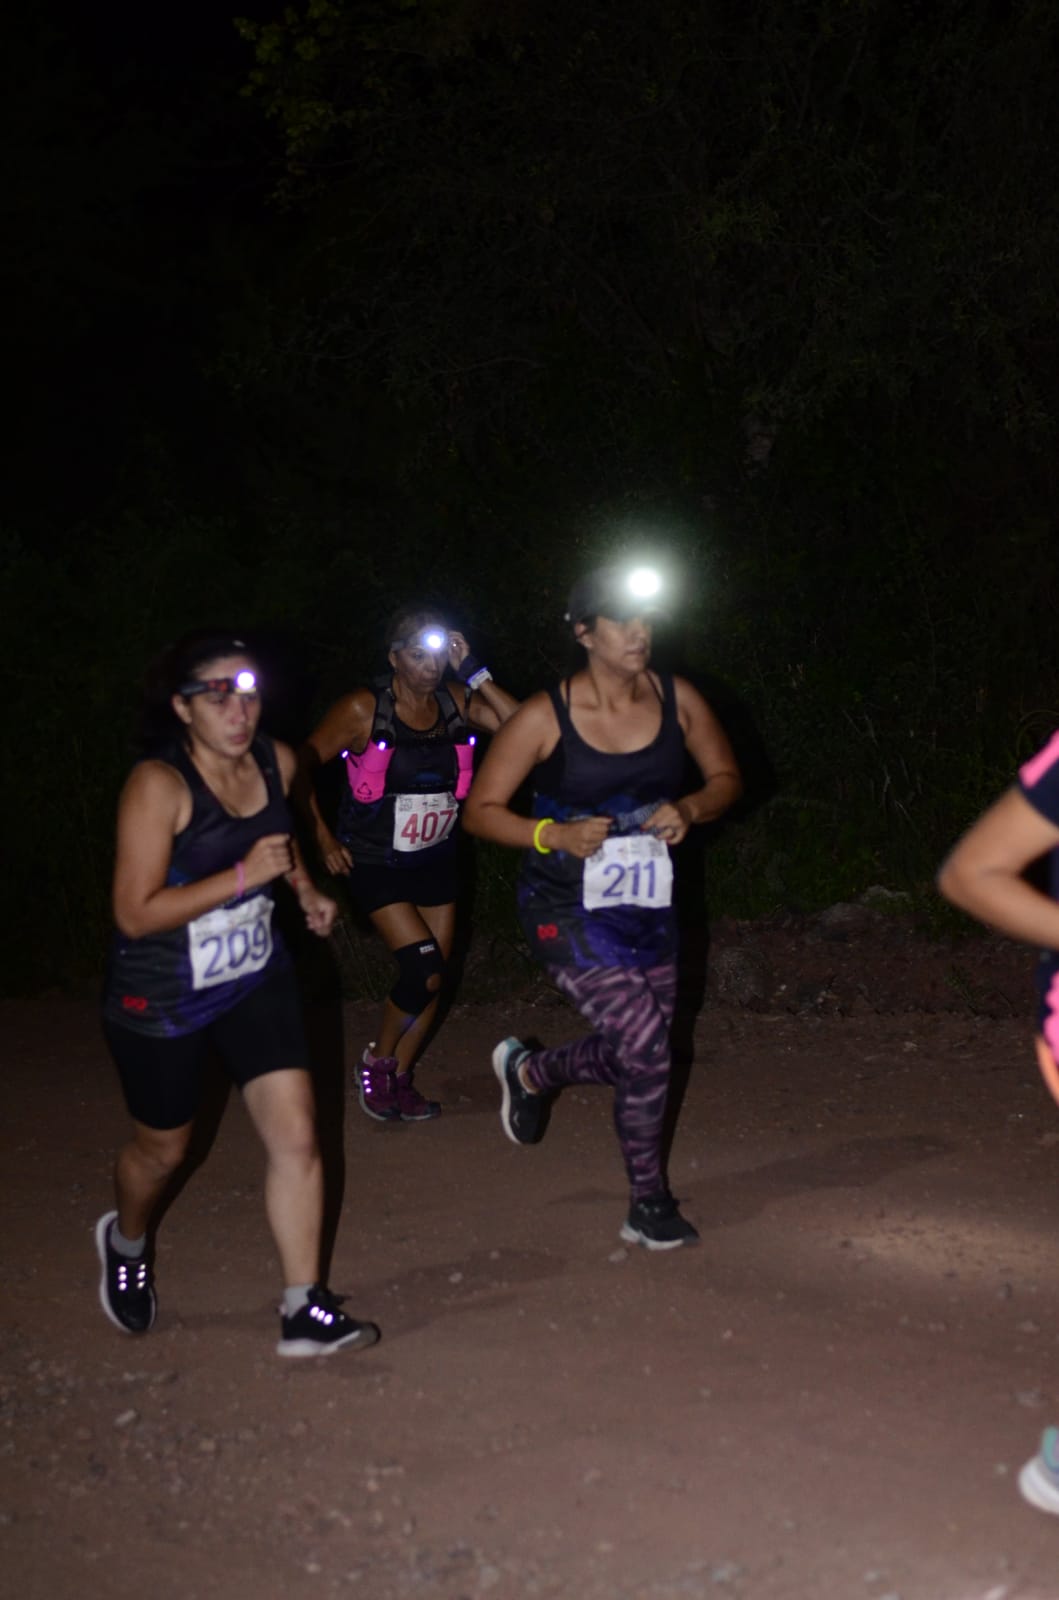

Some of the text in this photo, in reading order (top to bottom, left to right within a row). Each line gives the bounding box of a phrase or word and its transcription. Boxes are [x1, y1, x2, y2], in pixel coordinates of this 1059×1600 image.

[401, 809, 454, 844] 407
[602, 860, 656, 898] 211
[200, 920, 269, 979] 209
